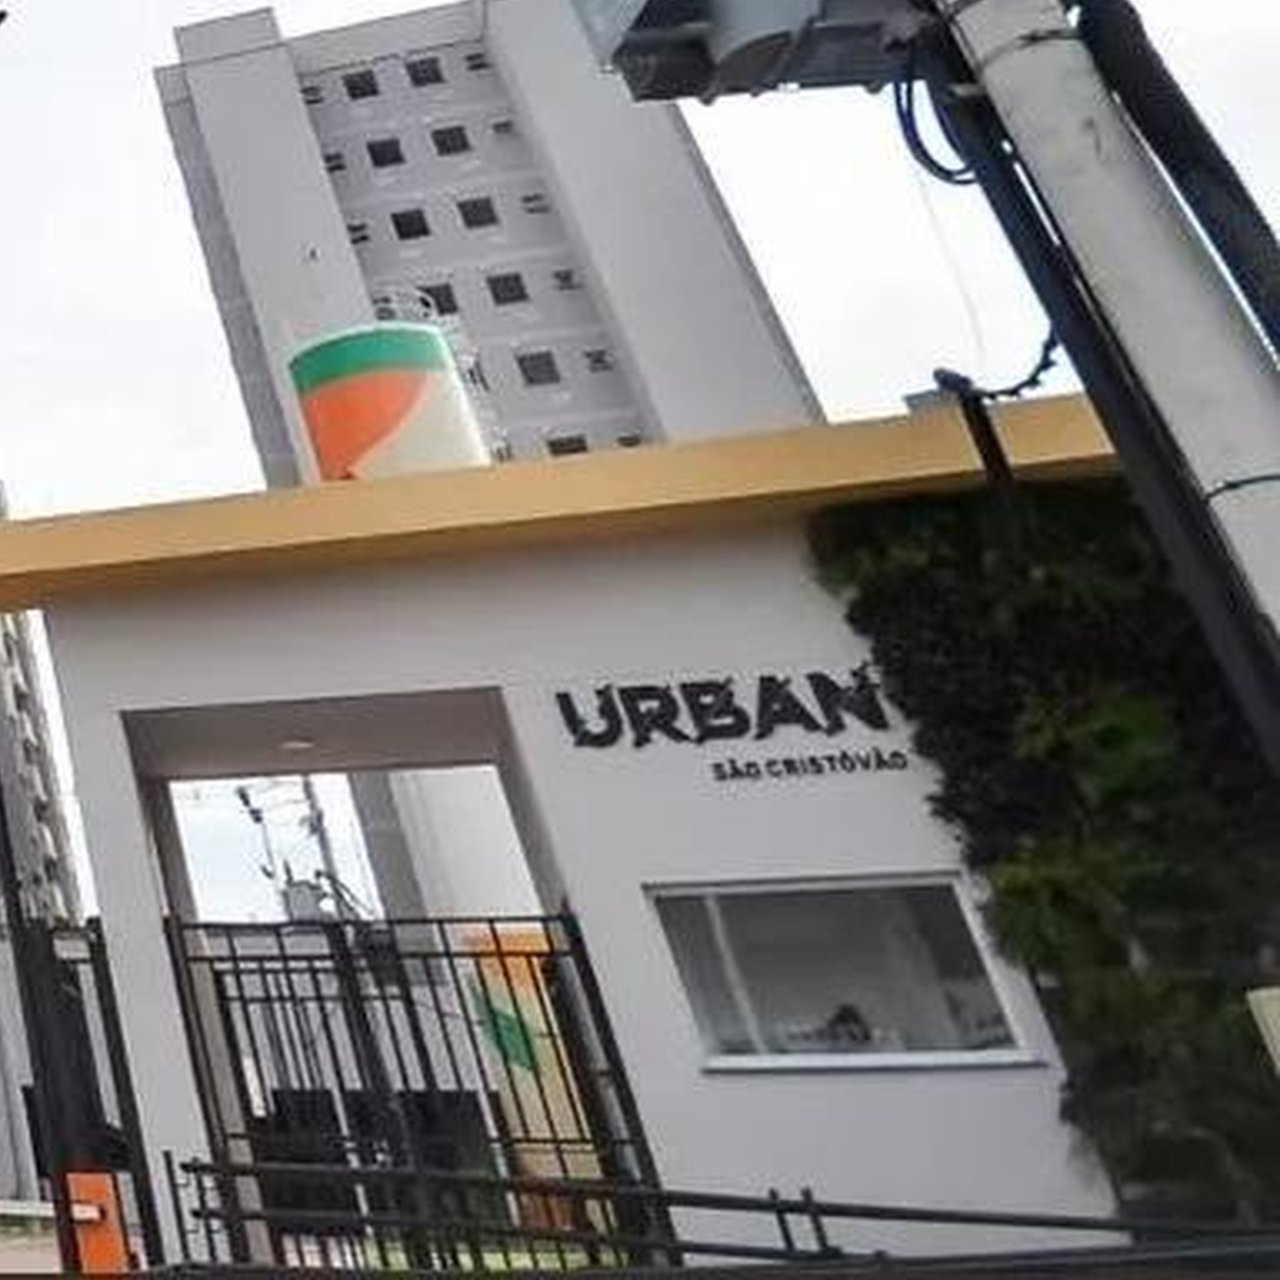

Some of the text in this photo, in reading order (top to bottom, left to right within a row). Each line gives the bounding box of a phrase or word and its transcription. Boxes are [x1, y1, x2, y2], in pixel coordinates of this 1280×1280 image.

[555, 666, 890, 748] URBAN
[712, 748, 909, 782] SÃO CRISTÓVÃO
